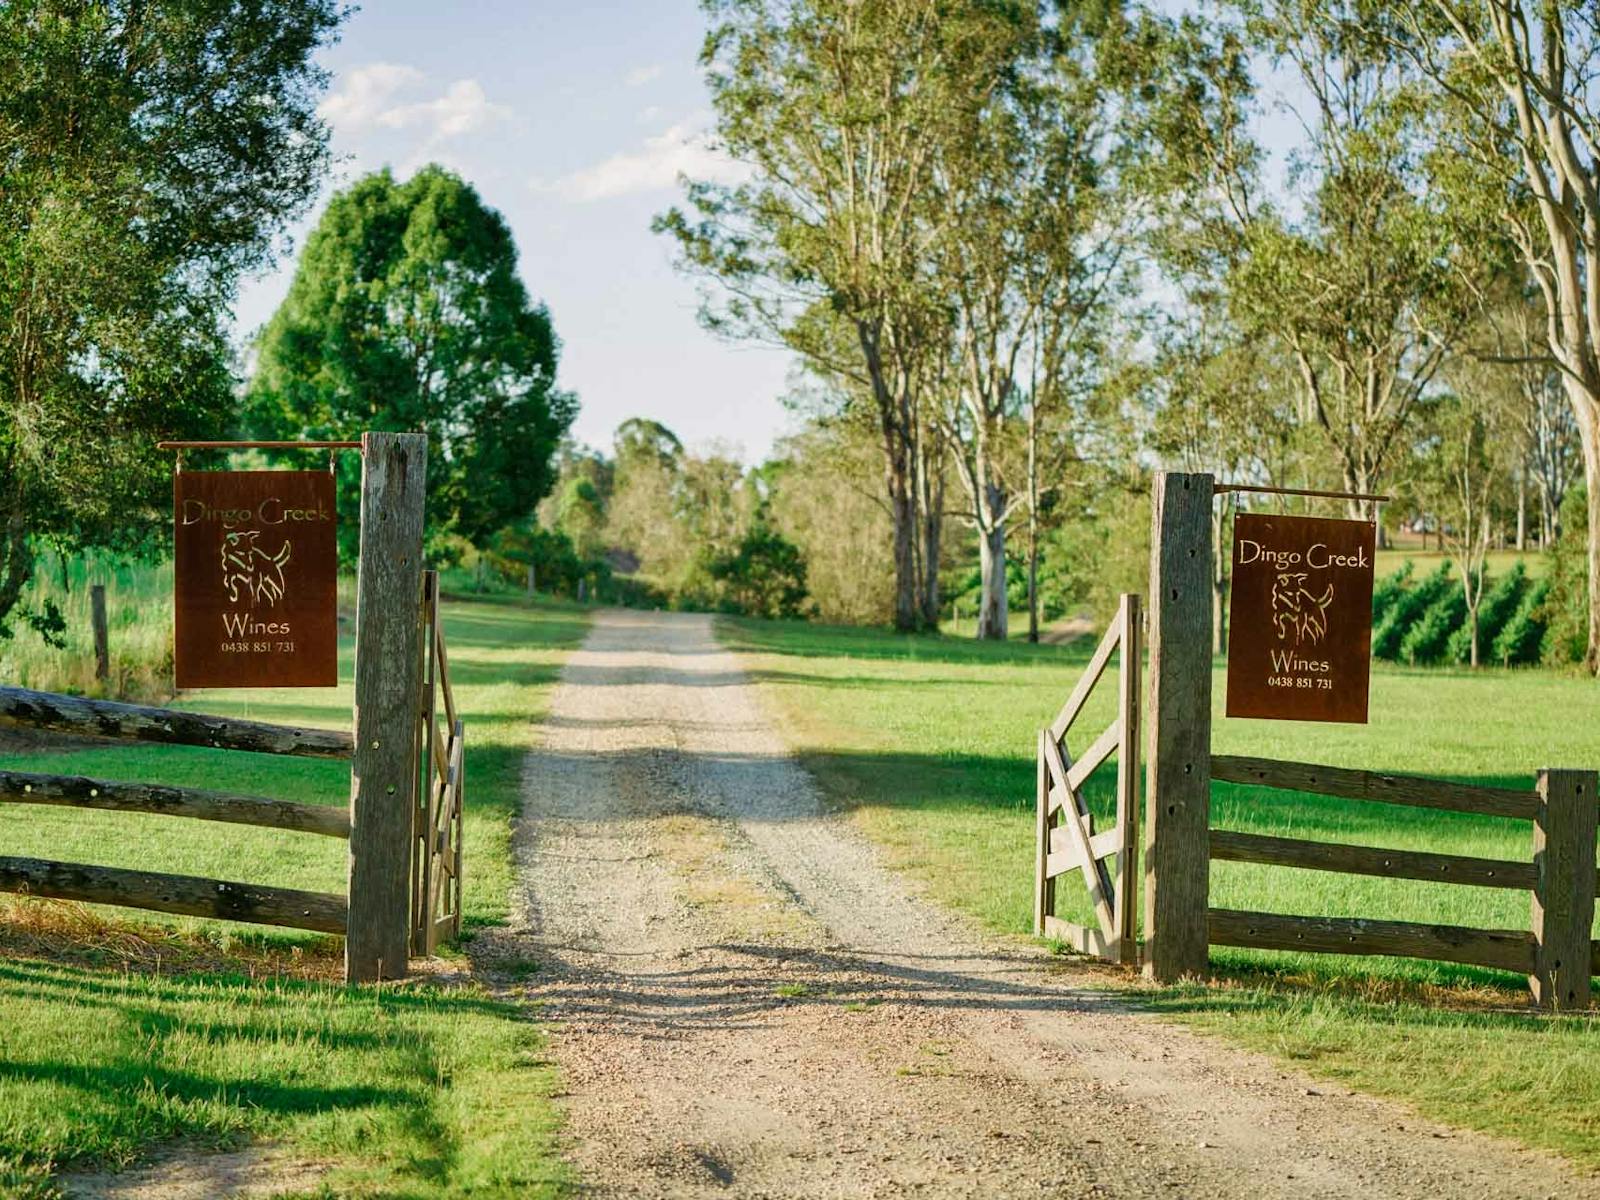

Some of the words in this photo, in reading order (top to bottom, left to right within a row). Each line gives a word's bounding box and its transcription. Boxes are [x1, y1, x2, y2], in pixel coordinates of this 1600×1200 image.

[181, 499, 252, 528] Dingo
[258, 498, 331, 525] Creek
[1239, 539, 1301, 570] Dingo
[1306, 543, 1369, 569] Creek
[222, 612, 290, 638] Wines
[221, 641, 249, 652] 0438
[253, 641, 271, 652] 851
[277, 641, 295, 652] 731
[1270, 649, 1330, 673] Wines
[1267, 676, 1293, 687] 0438
[1296, 677, 1312, 688] 851
[1316, 678, 1332, 689] 731
